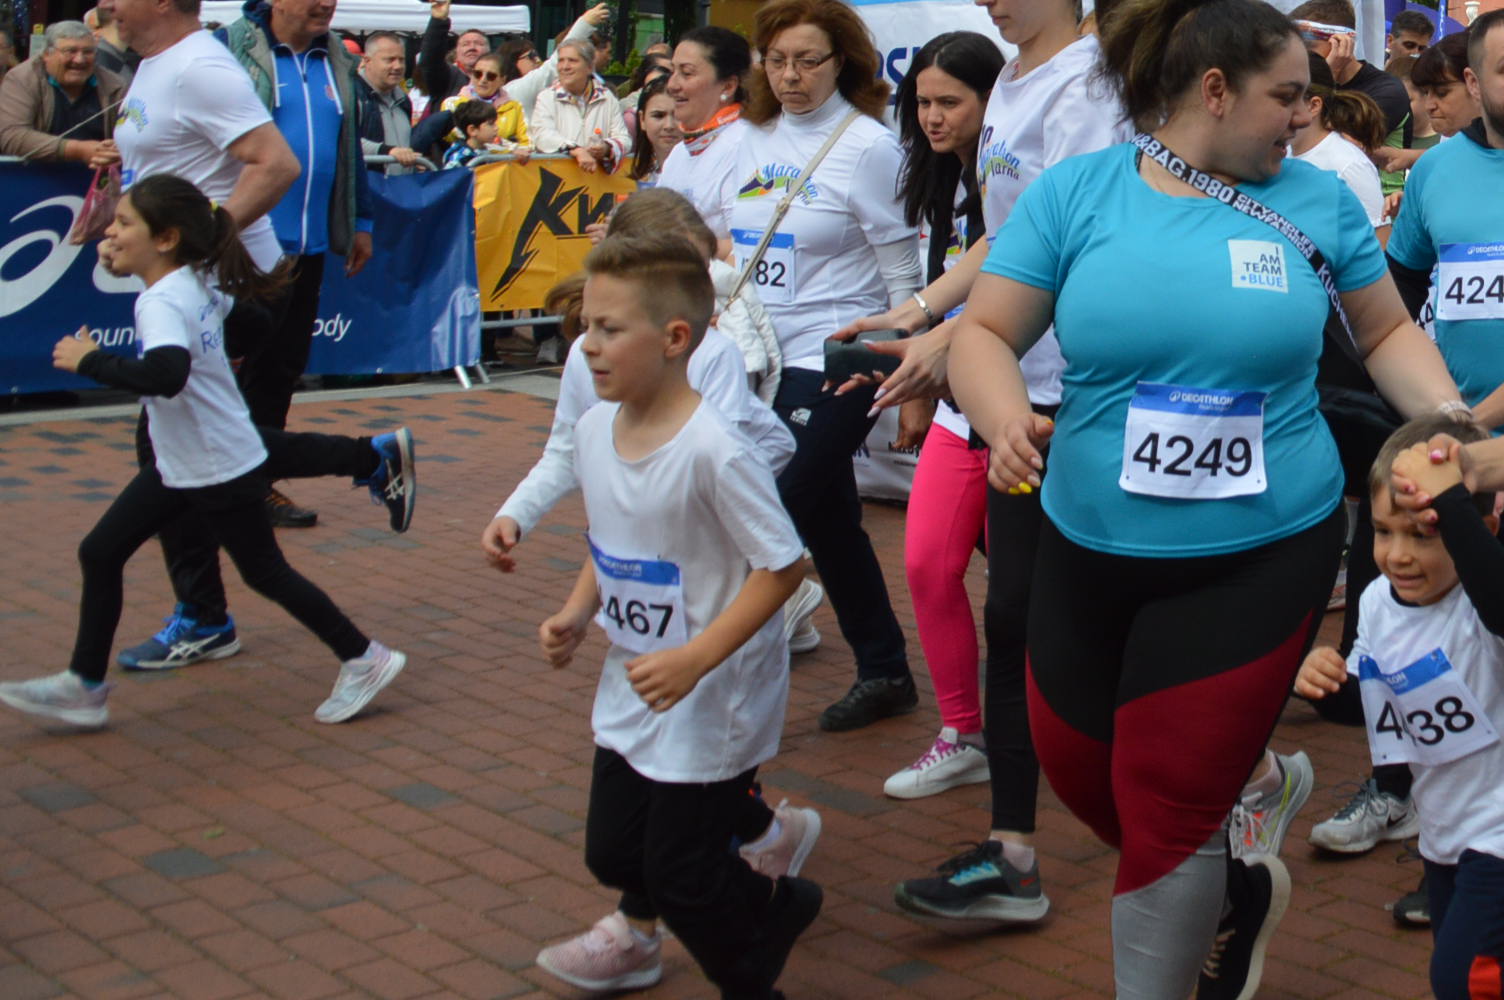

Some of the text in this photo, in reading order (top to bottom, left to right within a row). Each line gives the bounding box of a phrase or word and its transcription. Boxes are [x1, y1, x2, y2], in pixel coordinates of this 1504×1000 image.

[750, 258, 786, 287] 82
[1243, 262, 1282, 275] TEAM
[1260, 253, 1281, 265] AM
[1445, 275, 1504, 305] 424
[74, 326, 134, 347] soun
[312, 312, 352, 342] ody
[1181, 392, 1234, 406] DECATHLON
[1133, 431, 1252, 478] 4249
[606, 595, 673, 639] 467
[1375, 696, 1476, 747] 438
